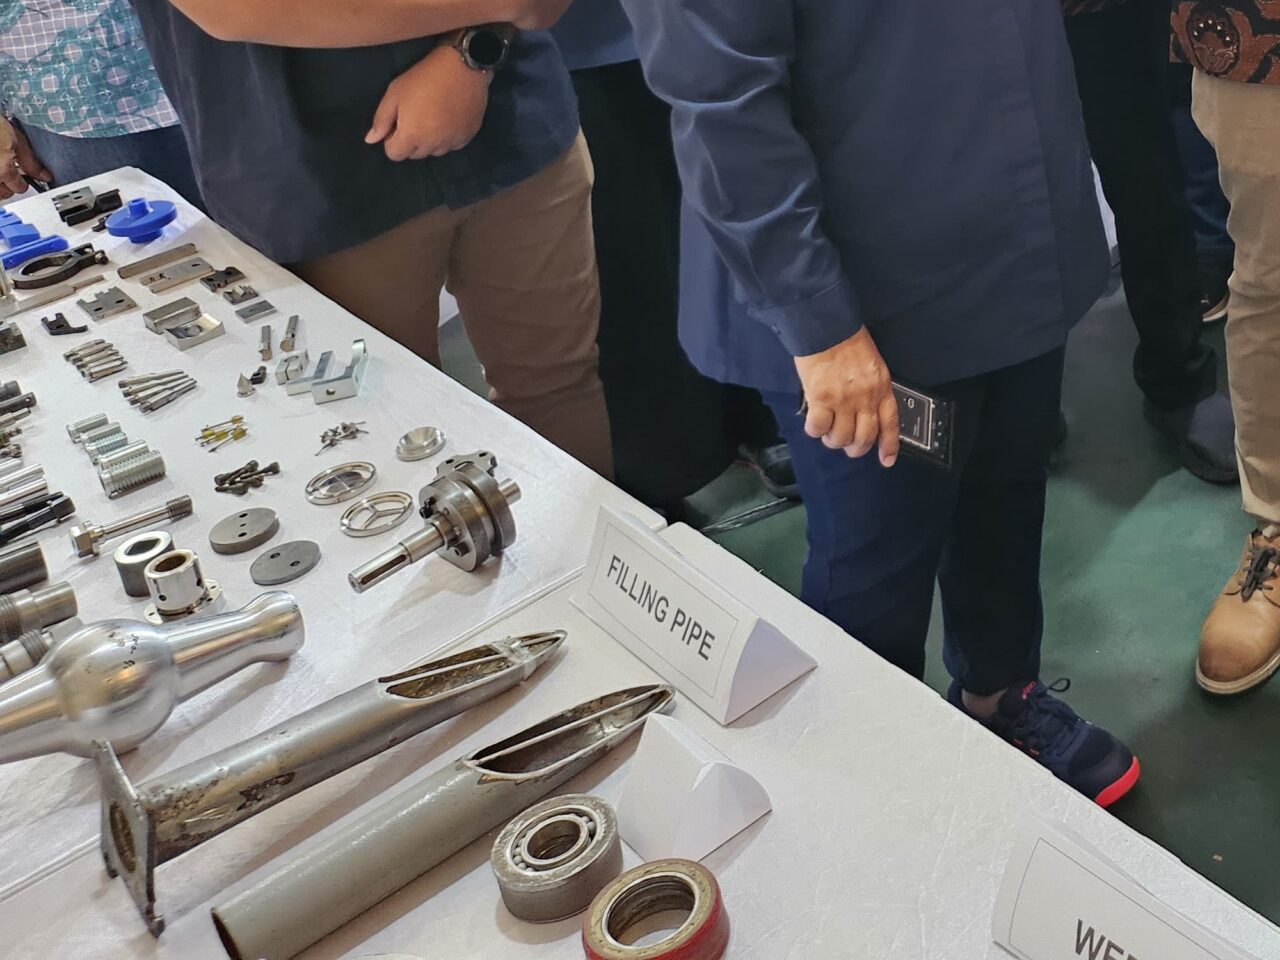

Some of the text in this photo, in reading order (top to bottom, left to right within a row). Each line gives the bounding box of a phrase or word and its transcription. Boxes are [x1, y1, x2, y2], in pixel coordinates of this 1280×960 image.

[607, 554, 715, 661] FILLING PIPE
[1074, 917, 1139, 960] WE
